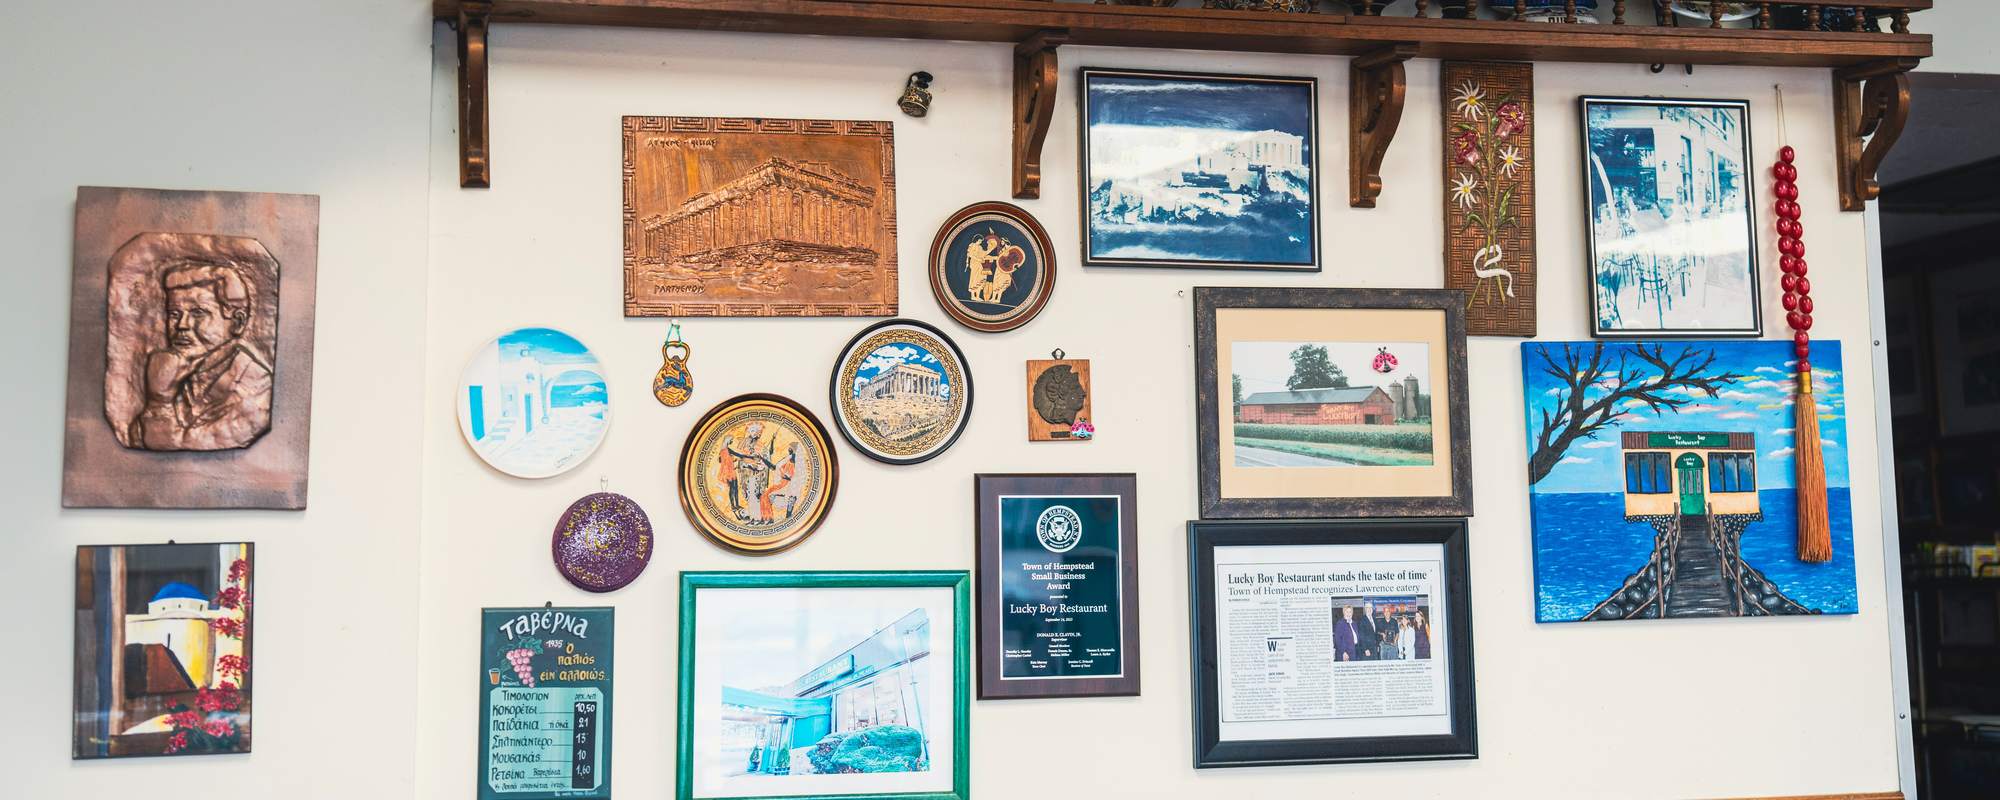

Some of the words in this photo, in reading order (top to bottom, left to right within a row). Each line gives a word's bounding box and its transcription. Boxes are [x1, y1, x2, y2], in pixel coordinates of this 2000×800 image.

[1022, 562, 1042, 570] Town
[1044, 562, 1053, 570] of
[1053, 562, 1095, 571] Hempstead
[1031, 572, 1053, 580] Small
[1054, 572, 1086, 580] Business
[1228, 573, 1255, 586] Lucky
[1257, 573, 1275, 586] Boy
[1277, 572, 1326, 583] Restaurant
[1327, 570, 1356, 582] stands
[1358, 570, 1372, 581] the
[1374, 570, 1395, 581] taste
[1397, 569, 1407, 580] of
[1408, 570, 1428, 580] time
[1046, 582, 1071, 590] Award
[1228, 586, 1251, 596] Town
[1253, 586, 1262, 596] of
[1263, 585, 1309, 597] Hempstead
[1311, 584, 1354, 595] recognizes
[1355, 584, 1394, 593] Lawrence
[1396, 584, 1421, 594] eatery
[1010, 604, 1038, 616] Lucky
[1039, 603, 1058, 616] Boy
[1059, 603, 1108, 613] Restaurant
[575, 702, 596, 714] 10,50
[578, 717, 589, 728] 21
[577, 749, 587, 760] 10
